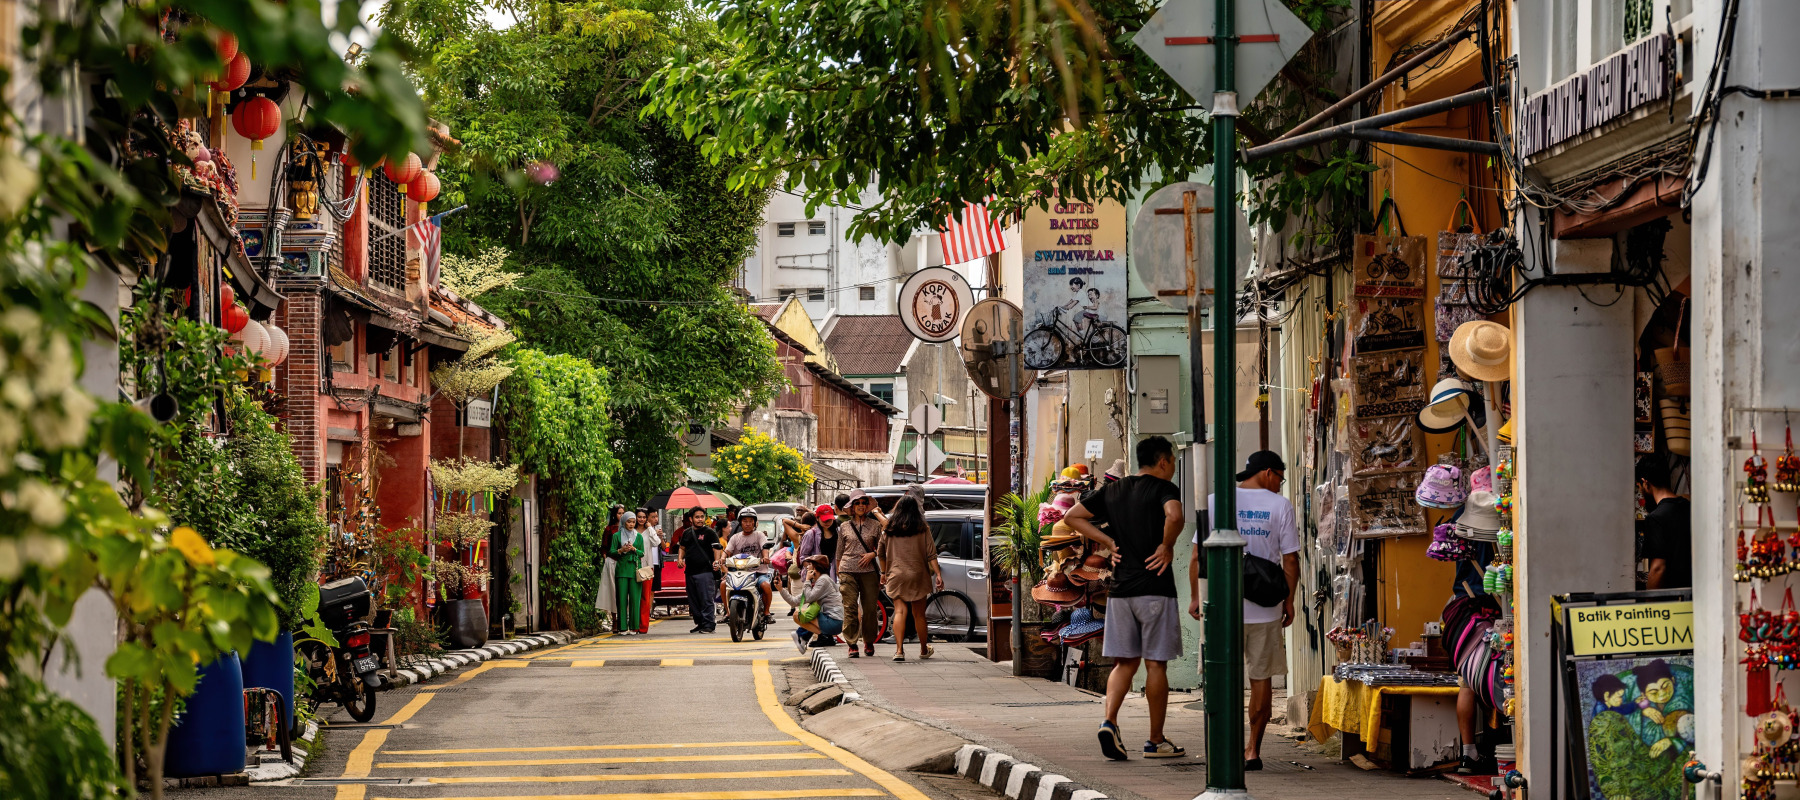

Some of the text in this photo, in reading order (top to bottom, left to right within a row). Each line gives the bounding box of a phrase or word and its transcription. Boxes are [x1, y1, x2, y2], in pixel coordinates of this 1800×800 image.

[1547, 75, 1586, 149] PAINTING
[1586, 54, 1625, 130] MUSEUM
[1625, 34, 1667, 112] PENANG
[1054, 203, 1094, 214] GIFTS
[1050, 218, 1099, 229] BATIKS
[1057, 234, 1092, 245] ARTS
[1035, 250, 1115, 261] SWIMWEAR
[1048, 265, 1066, 275] and
[922, 284, 946, 296] KOPI
[921, 312, 952, 332] LOEWAK
[1240, 527, 1271, 538] holiday
[1578, 607, 1671, 623] Batik Painting
[1592, 625, 1694, 649] MUSEUM
